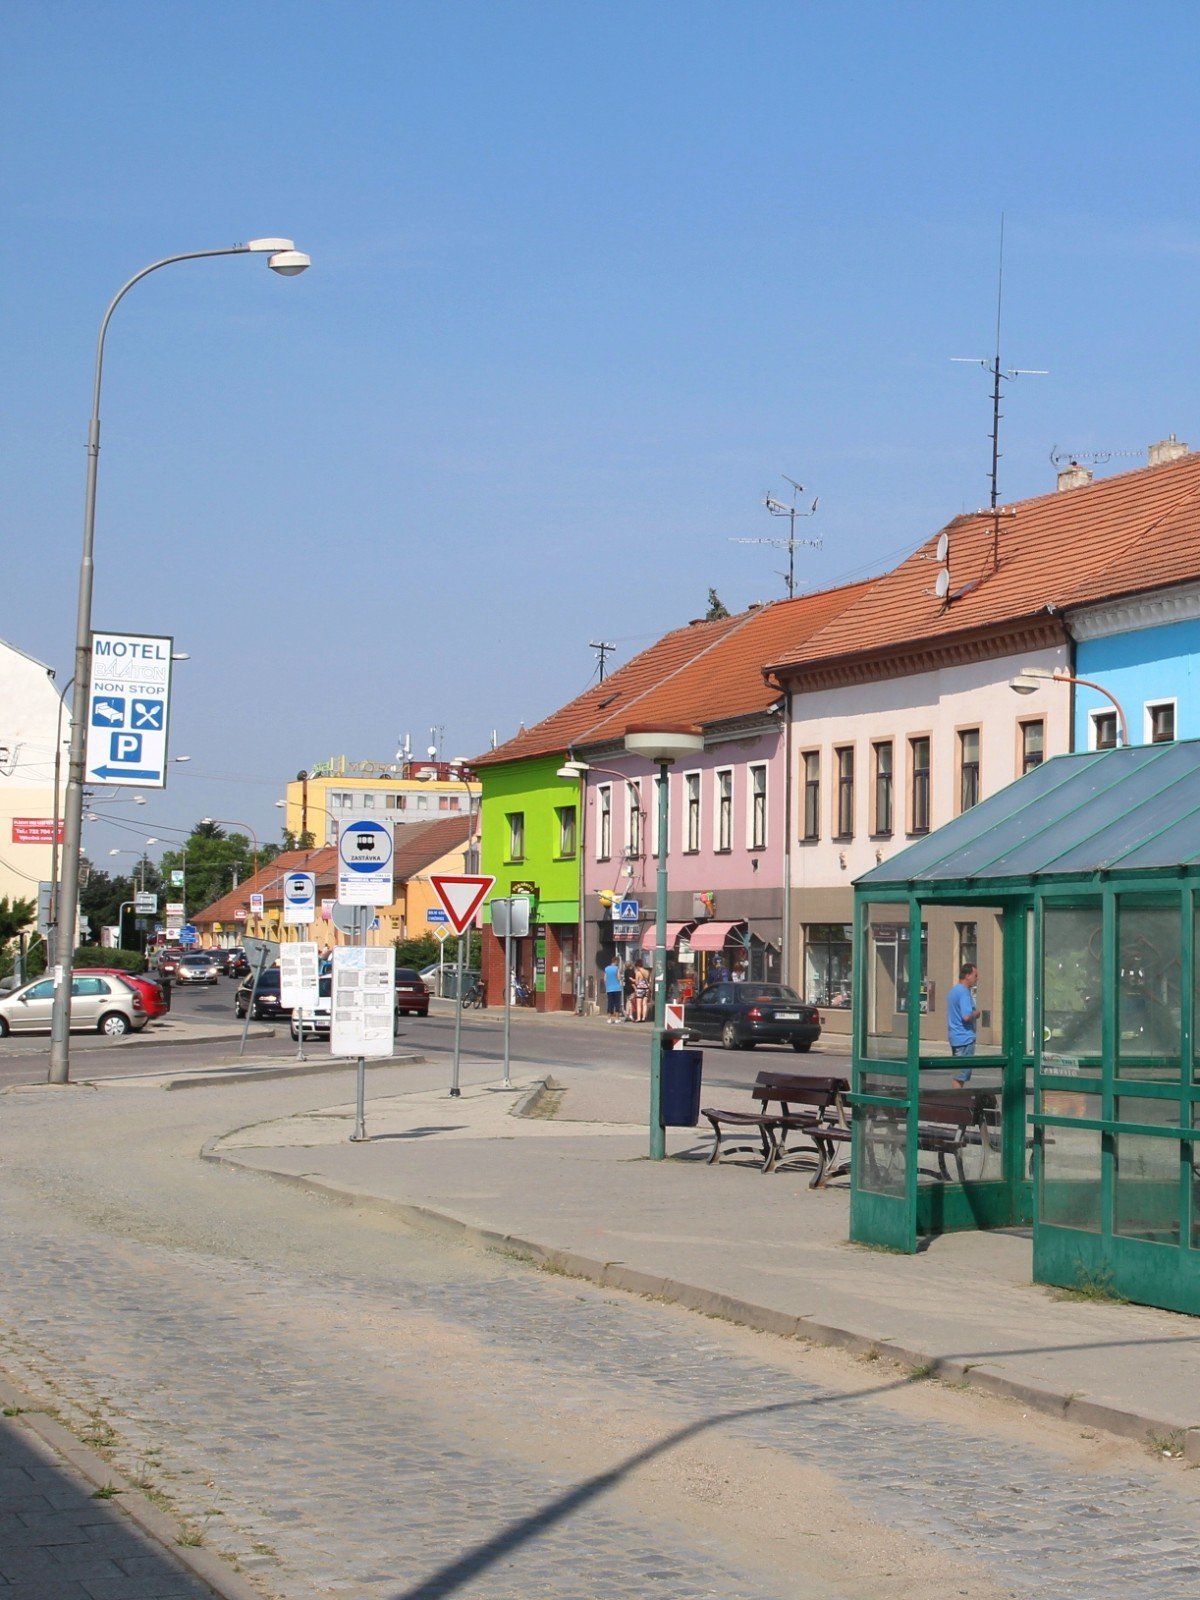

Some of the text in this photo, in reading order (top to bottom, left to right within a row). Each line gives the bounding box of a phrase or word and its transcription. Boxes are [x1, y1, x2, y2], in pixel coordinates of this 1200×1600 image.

[95, 640, 166, 661] MOTEL
[94, 682, 165, 695] NON STOP
[117, 735, 139, 760] P
